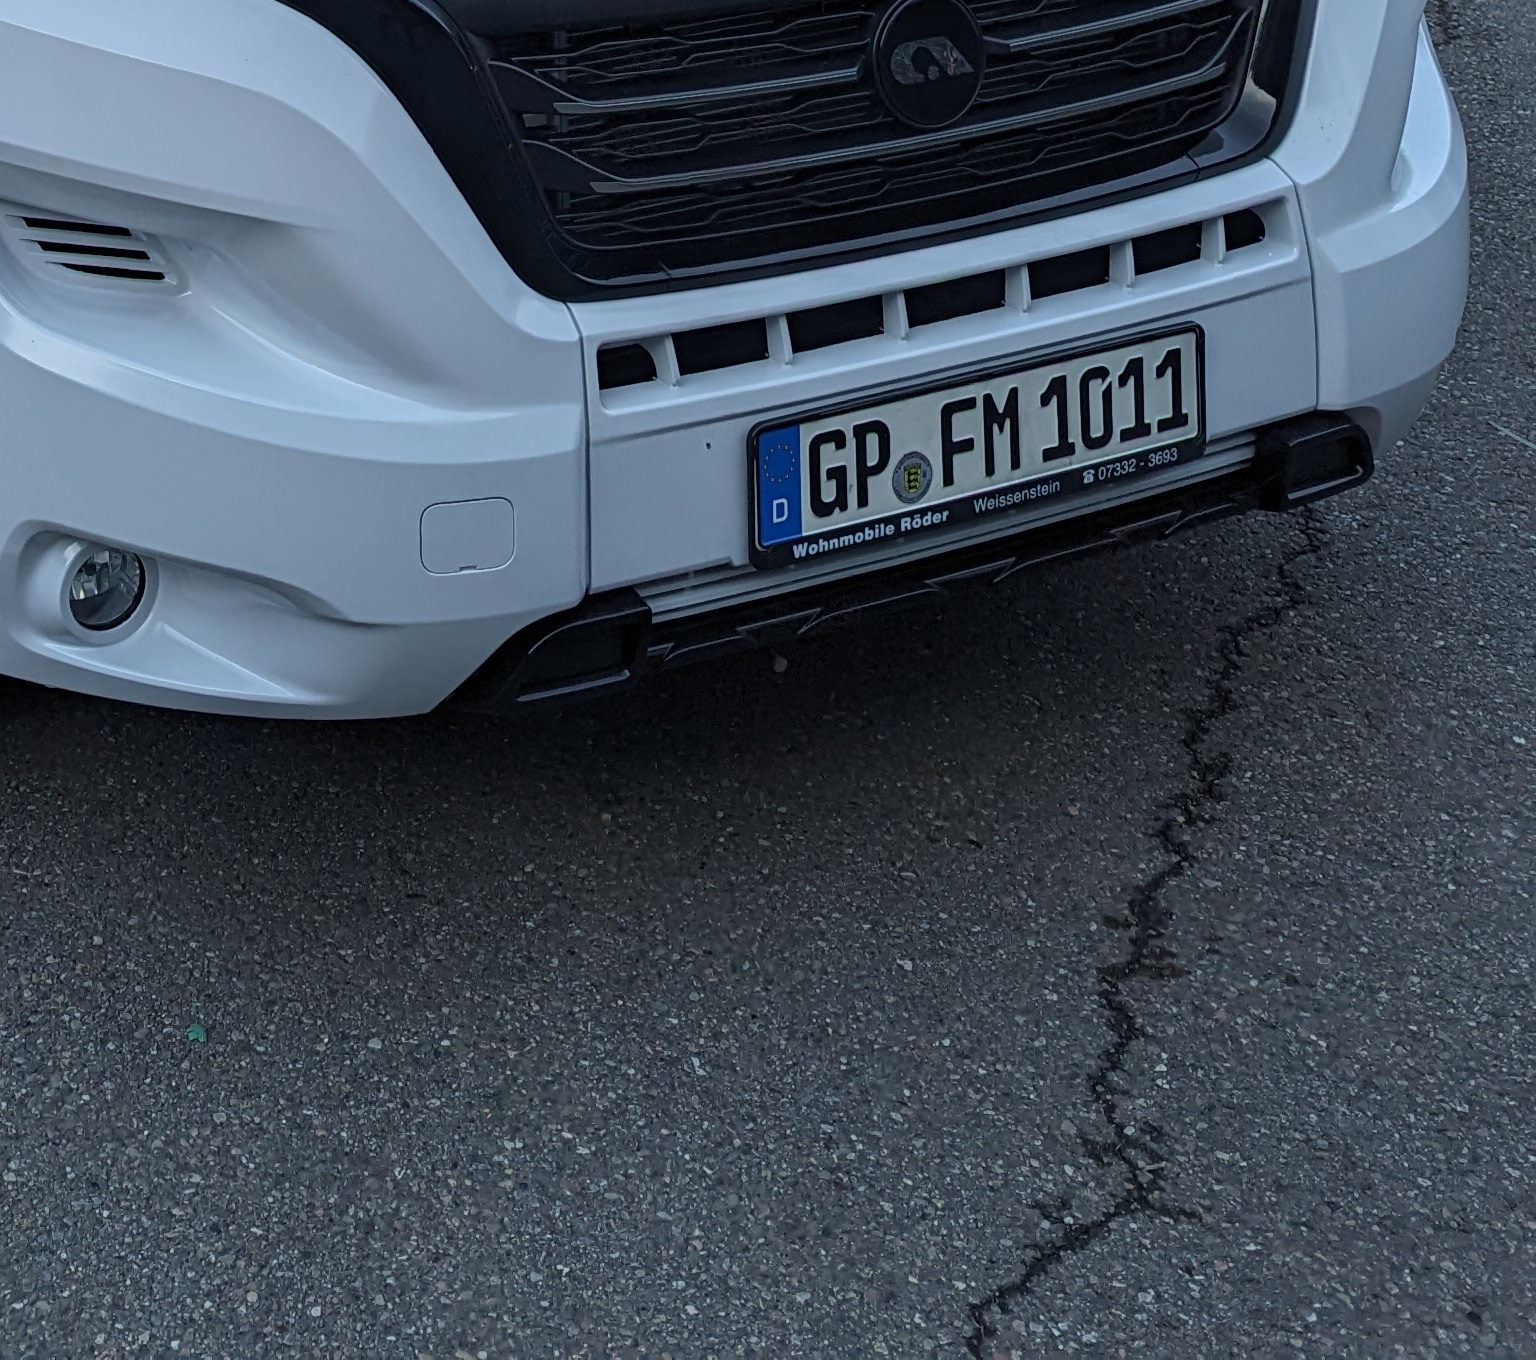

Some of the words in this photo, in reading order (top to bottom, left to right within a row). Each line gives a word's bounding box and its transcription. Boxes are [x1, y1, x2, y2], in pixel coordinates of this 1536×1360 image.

[808, 419, 891, 518] GP
[940, 386, 1020, 487] FM
[1039, 346, 1189, 462] 1011
[772, 498, 788, 524] D
[792, 523, 895, 559] Wohnmobile
[900, 510, 949, 532] Röder
[973, 481, 1060, 513] Weissenstein
[1098, 458, 1136, 480] 07332
[1148, 448, 1178, 468] 3693
